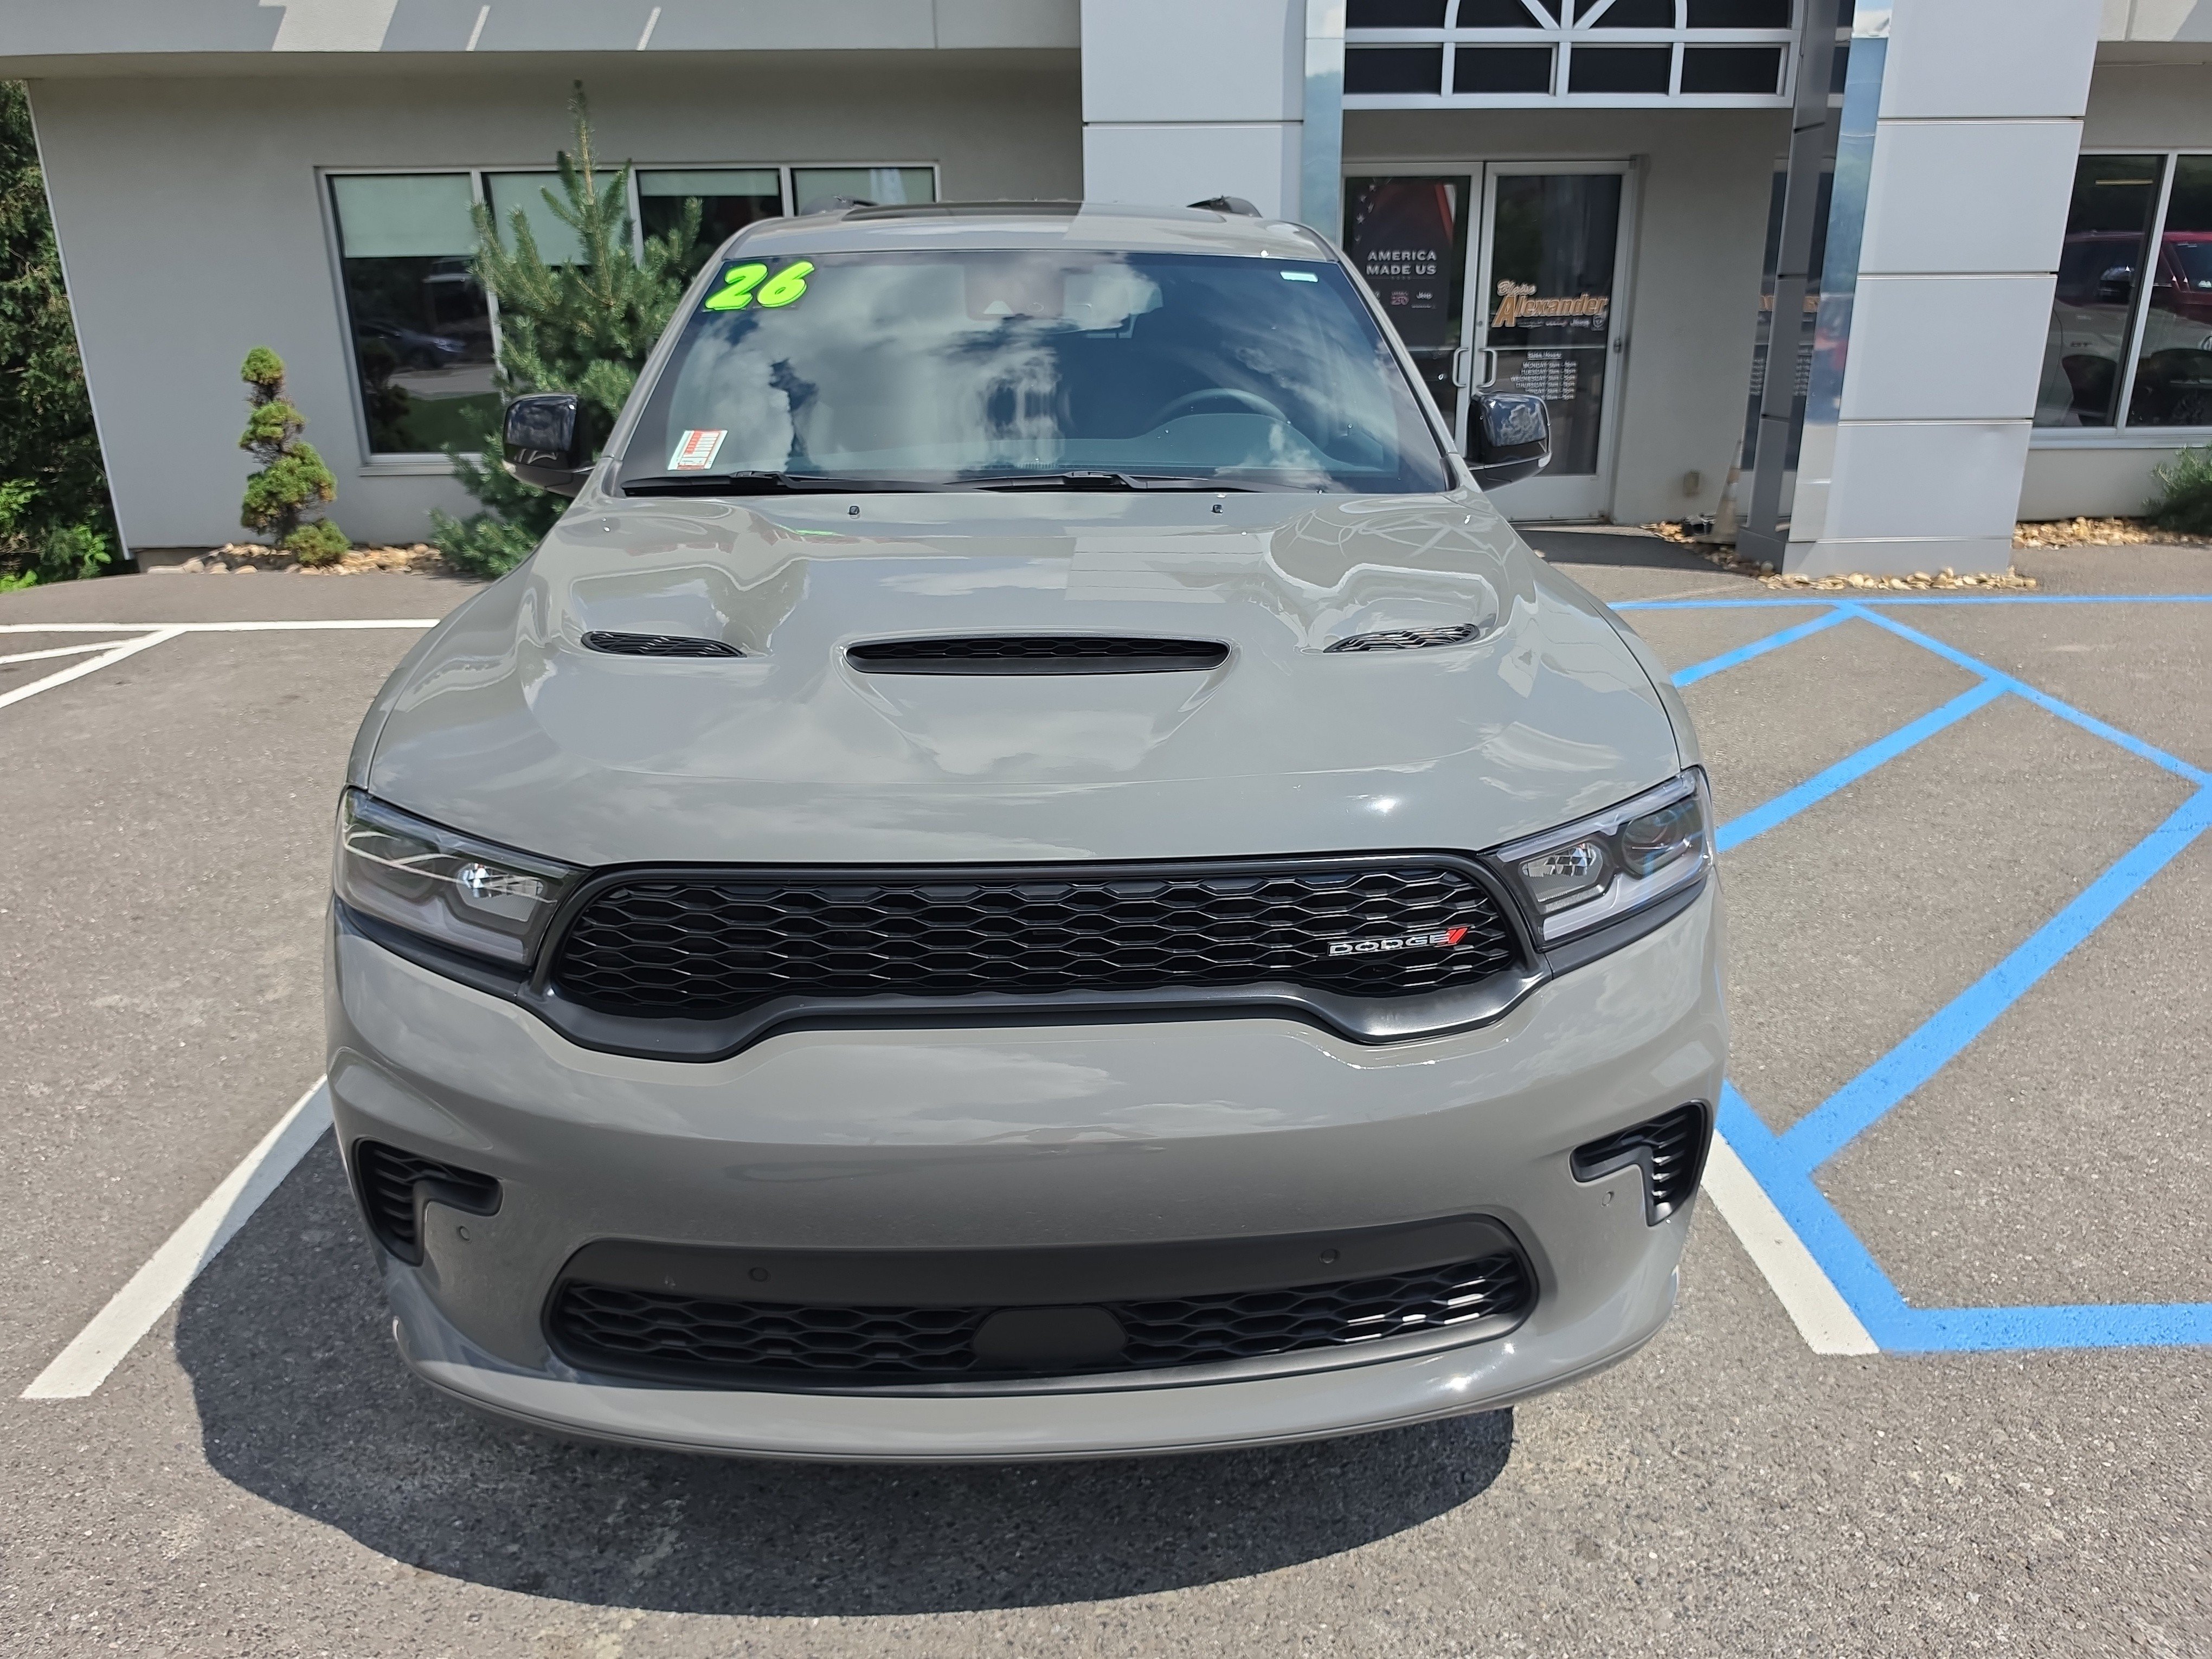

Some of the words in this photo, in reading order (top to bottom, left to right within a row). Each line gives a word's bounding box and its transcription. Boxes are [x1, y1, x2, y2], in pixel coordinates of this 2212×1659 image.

[1367, 250, 1437, 261] AMERICA
[1366, 264, 1411, 275] MADE
[1415, 264, 1437, 275] US
[705, 261, 815, 311] 26
[1491, 292, 1609, 327] Alexander
[1329, 934, 1451, 955] DODGE
